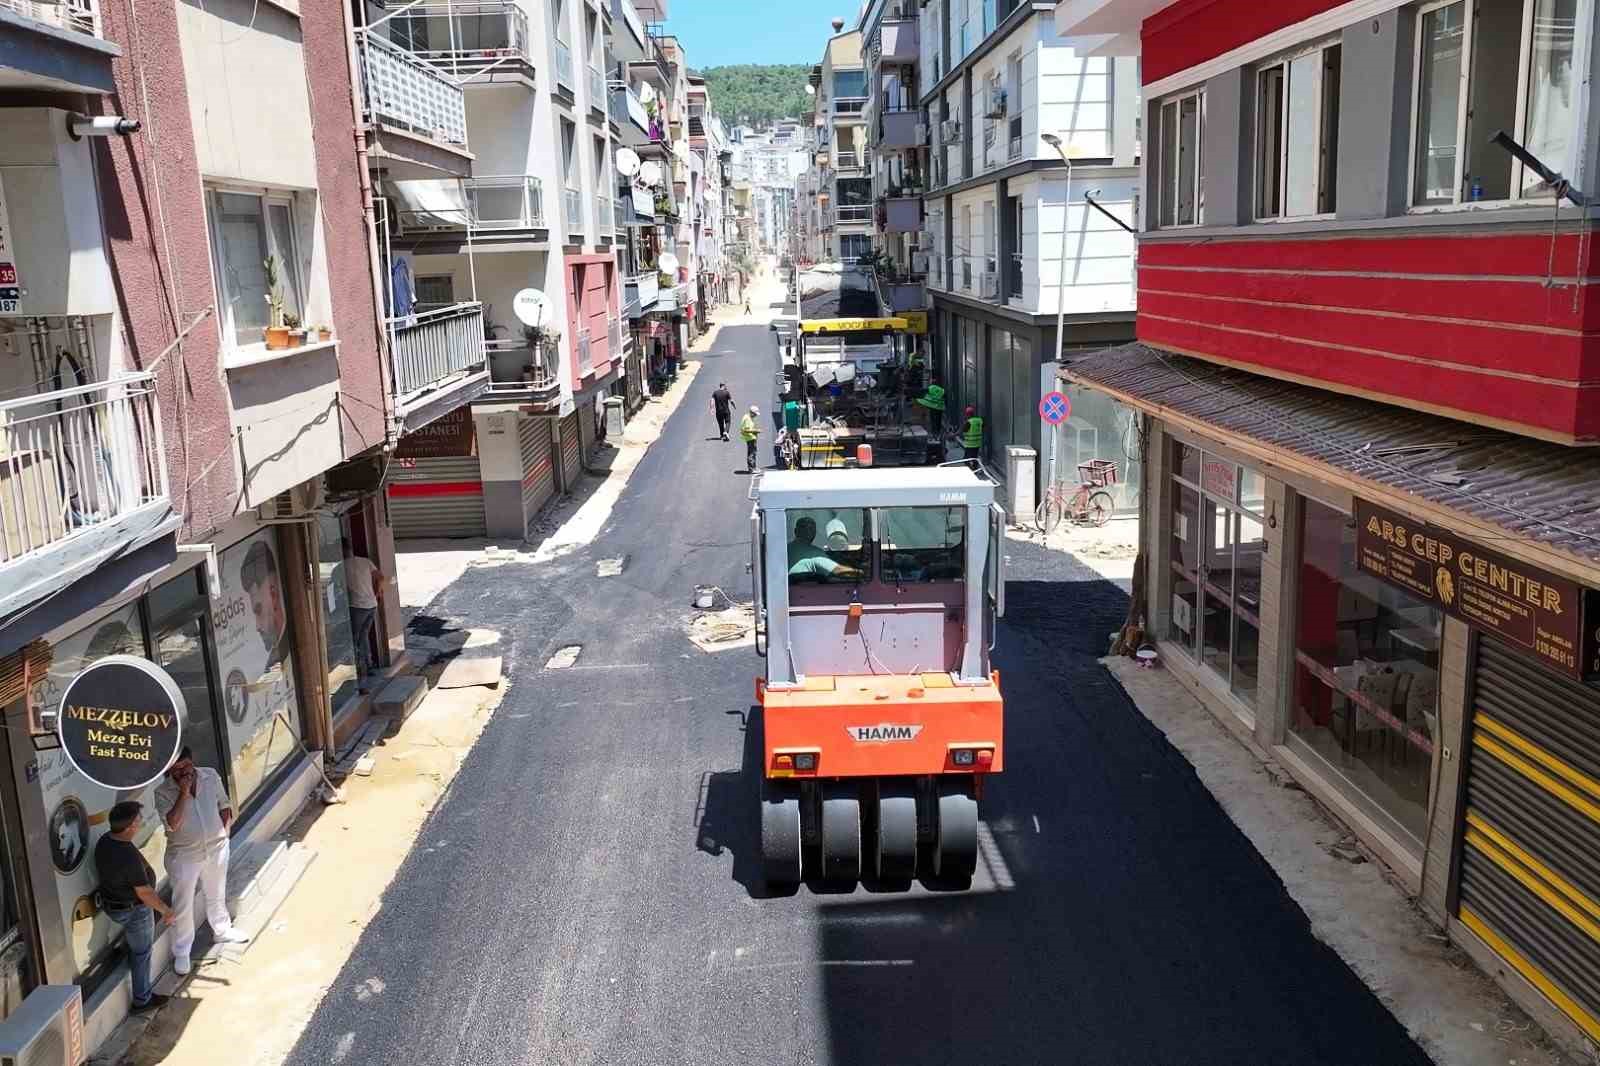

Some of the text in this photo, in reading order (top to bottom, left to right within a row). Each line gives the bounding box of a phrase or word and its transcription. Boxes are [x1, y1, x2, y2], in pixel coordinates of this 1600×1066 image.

[1367, 515, 1407, 548] ARS
[1411, 534, 1453, 564] CEP
[1458, 552, 1564, 614] CENTER
[67, 705, 173, 728] MEZZELOV
[88, 729, 152, 747] Meze Evi
[858, 727, 912, 740] HAMM
[90, 745, 150, 761] Fast Food
